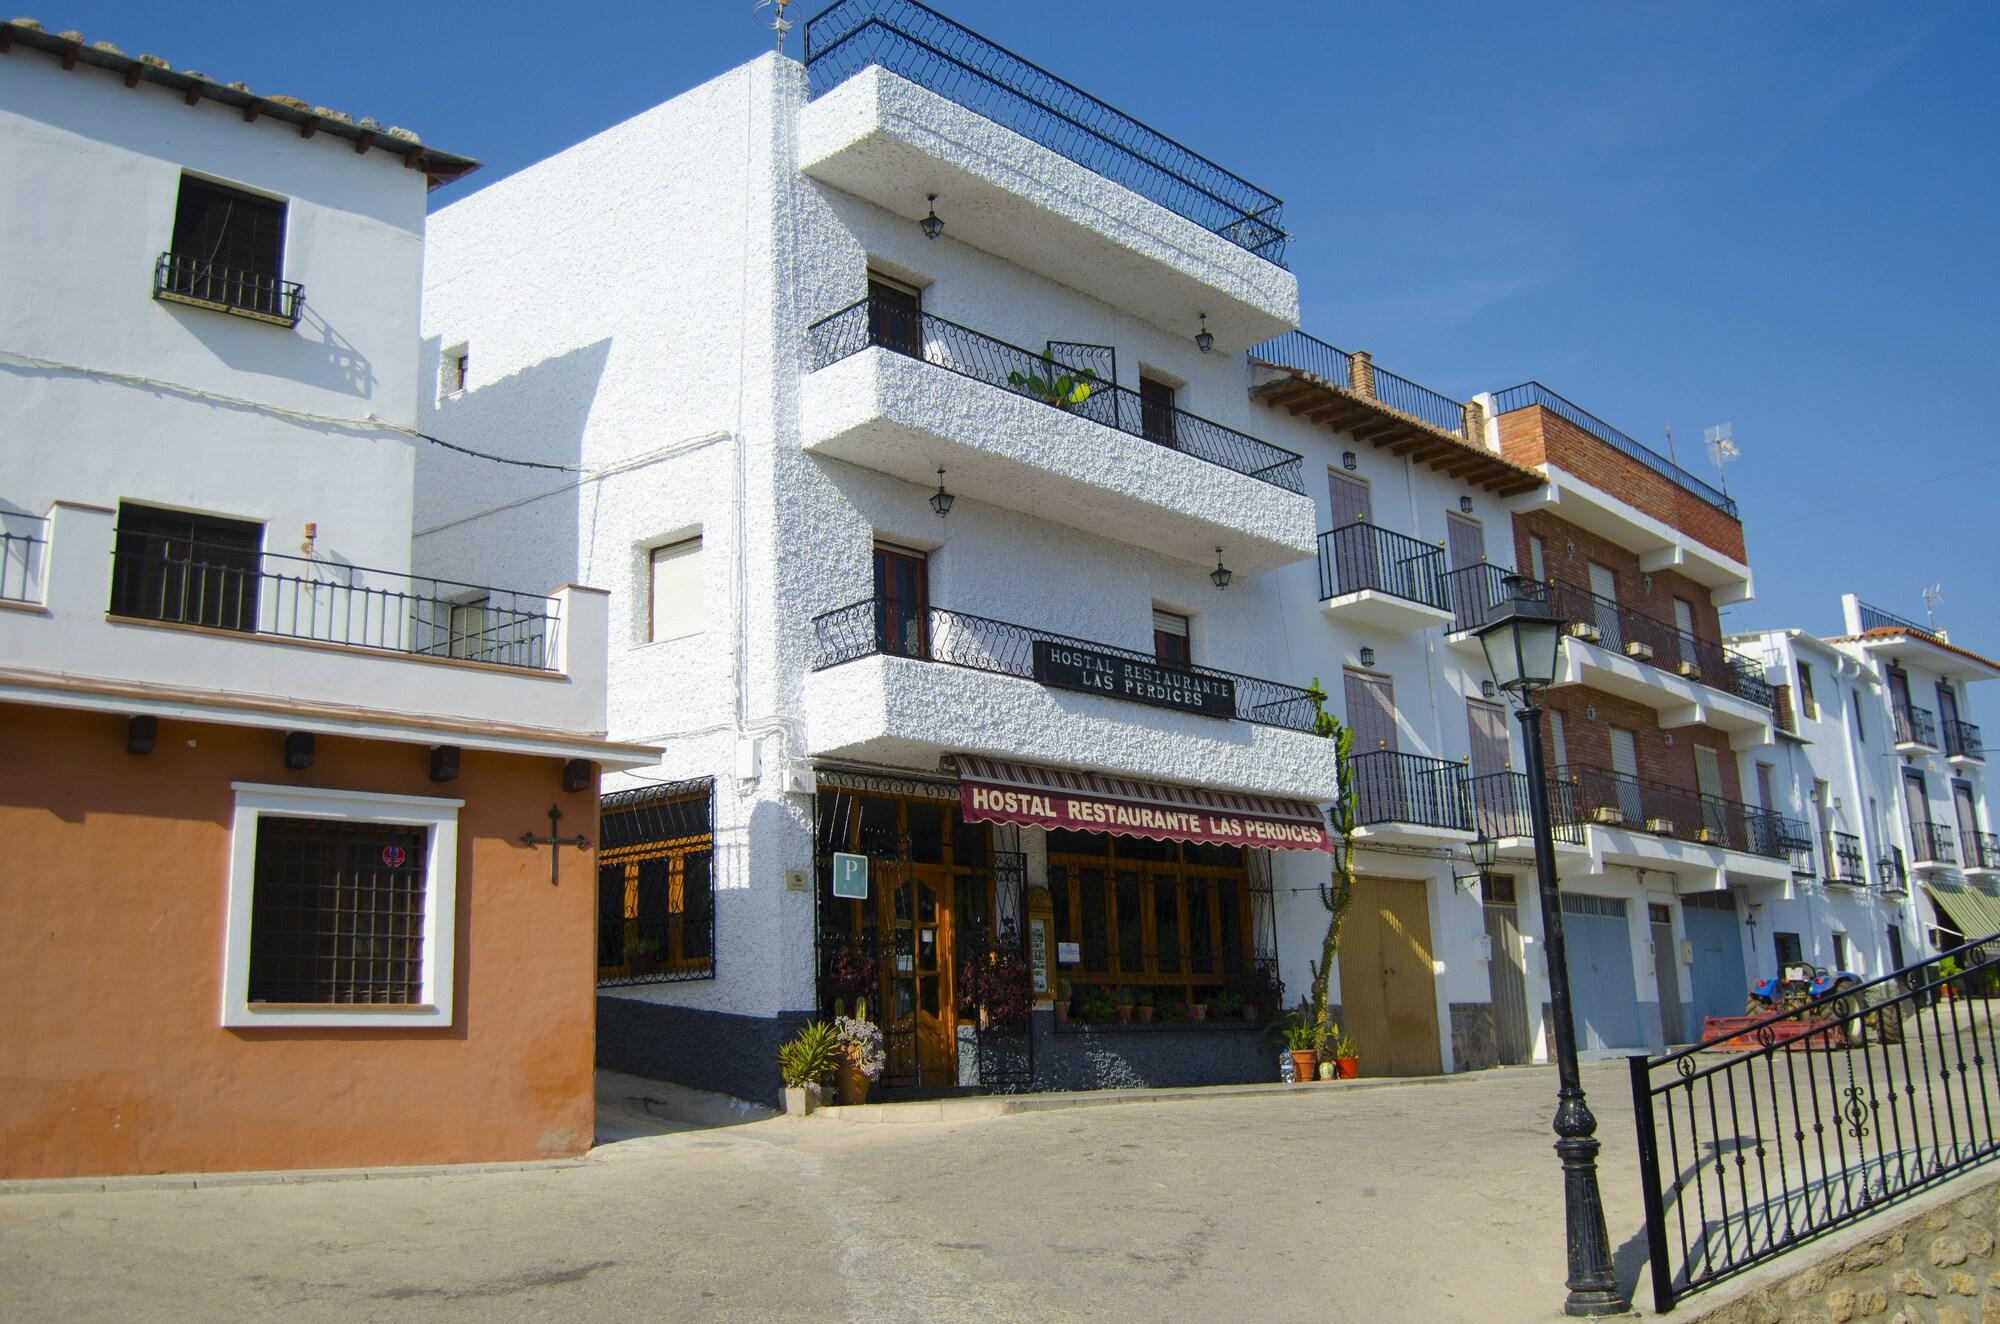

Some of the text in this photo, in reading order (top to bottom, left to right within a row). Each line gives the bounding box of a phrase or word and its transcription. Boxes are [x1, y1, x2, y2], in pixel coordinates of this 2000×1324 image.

[1051, 648, 1230, 697] HOSTAL RESTAURANTE
[1082, 671, 1203, 706] LAS PERDICES
[972, 788, 1322, 843] HOSTAL RESTAURANTE LAS PERDICES
[845, 859, 858, 880] P
